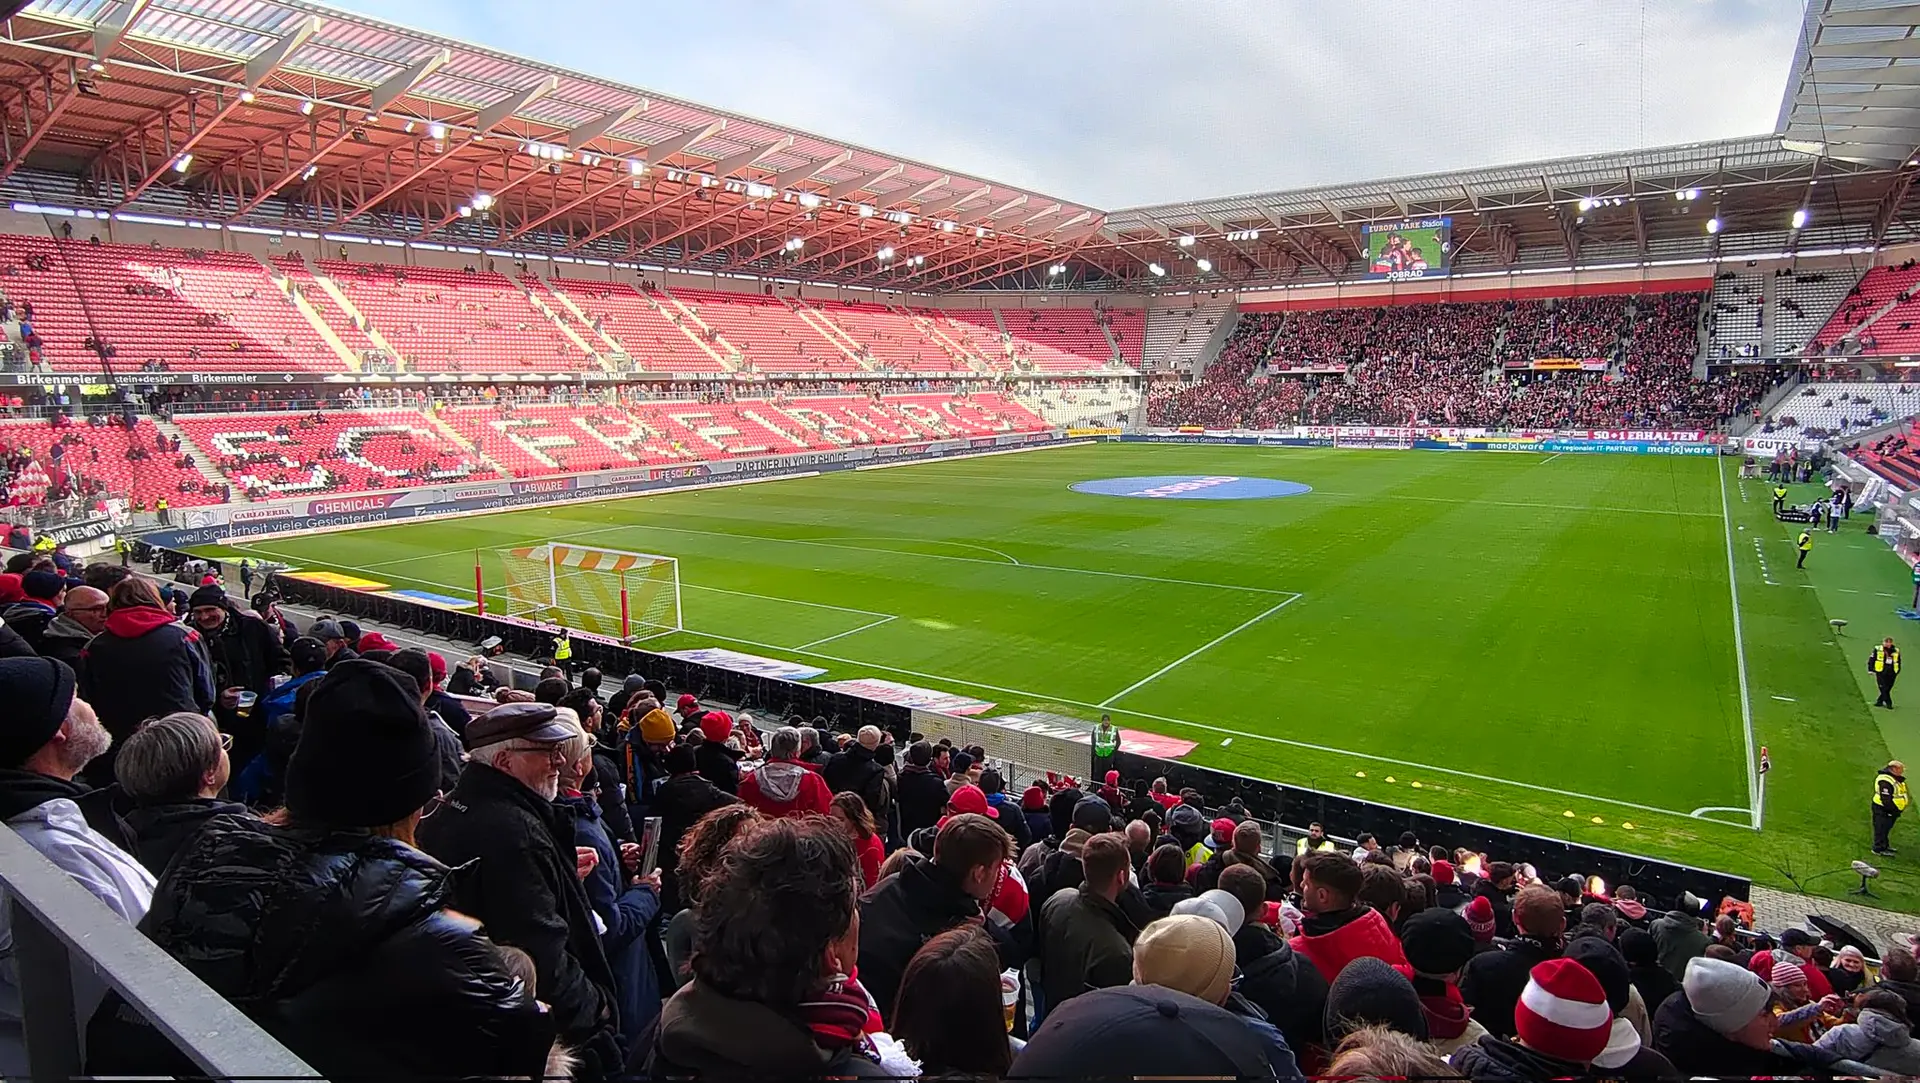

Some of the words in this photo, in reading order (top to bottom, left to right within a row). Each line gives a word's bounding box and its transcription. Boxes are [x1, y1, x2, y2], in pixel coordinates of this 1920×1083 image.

[1369, 224, 1398, 233] EUROPA
[1400, 222, 1420, 231] PARK
[1422, 220, 1444, 229] Stadion
[1386, 270, 1423, 279] JOBRAD
[17, 374, 98, 384] Birkenmeier
[192, 374, 257, 383] Birkenmeier
[1627, 430, 1699, 442] ERHALTEN
[1647, 445, 1713, 454] mae[x]ware
[1757, 440, 1798, 450] GUTEX
[652, 472, 671, 480] LIFE
[671, 467, 701, 478] SCIECE
[519, 481, 563, 494] LABWARE
[315, 498, 385, 514] CHEMICALS
[234, 511, 264, 520] CARLO
[266, 508, 291, 516] ERBA
[174, 531, 200, 544] weil
[203, 523, 267, 540] Sicherheit
[271, 522, 302, 532] viele
[306, 514, 366, 528] Gesichter
[367, 511, 388, 520] hat
